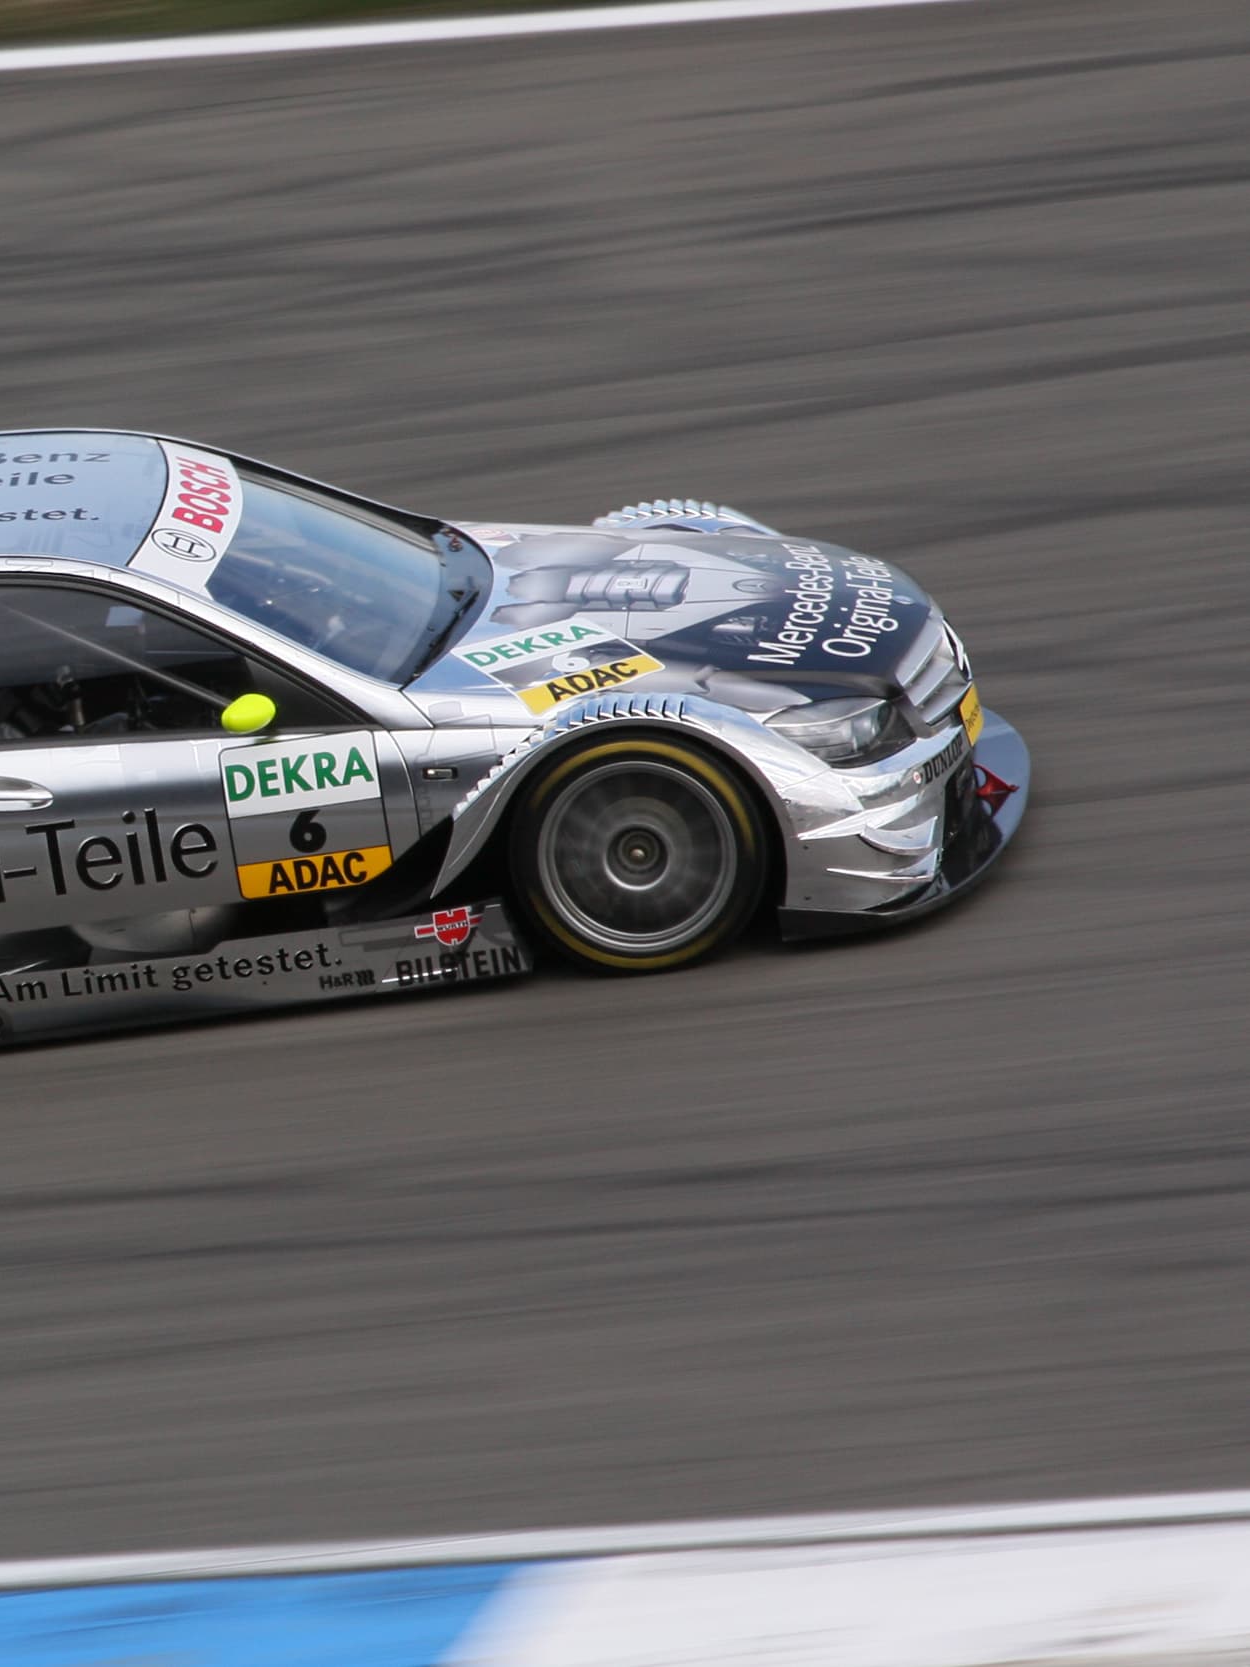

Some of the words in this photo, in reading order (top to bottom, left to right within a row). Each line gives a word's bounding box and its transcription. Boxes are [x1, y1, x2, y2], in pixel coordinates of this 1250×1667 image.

[172, 456, 231, 534] BOSCH
[747, 543, 834, 665] Mercedes-Benz
[822, 555, 899, 657] Original-Teile
[462, 624, 604, 667] DEKRA
[551, 652, 590, 674] 6
[546, 662, 639, 703] ADAC
[224, 746, 375, 803] DEKRA
[922, 733, 964, 785] DUNLOP
[289, 809, 327, 853] 6
[268, 852, 368, 894] ADAC
[61, 964, 159, 997] Limit
[172, 943, 343, 991] getestet.
[319, 972, 355, 990] H&R
[396, 944, 524, 987] BILSTEIN
